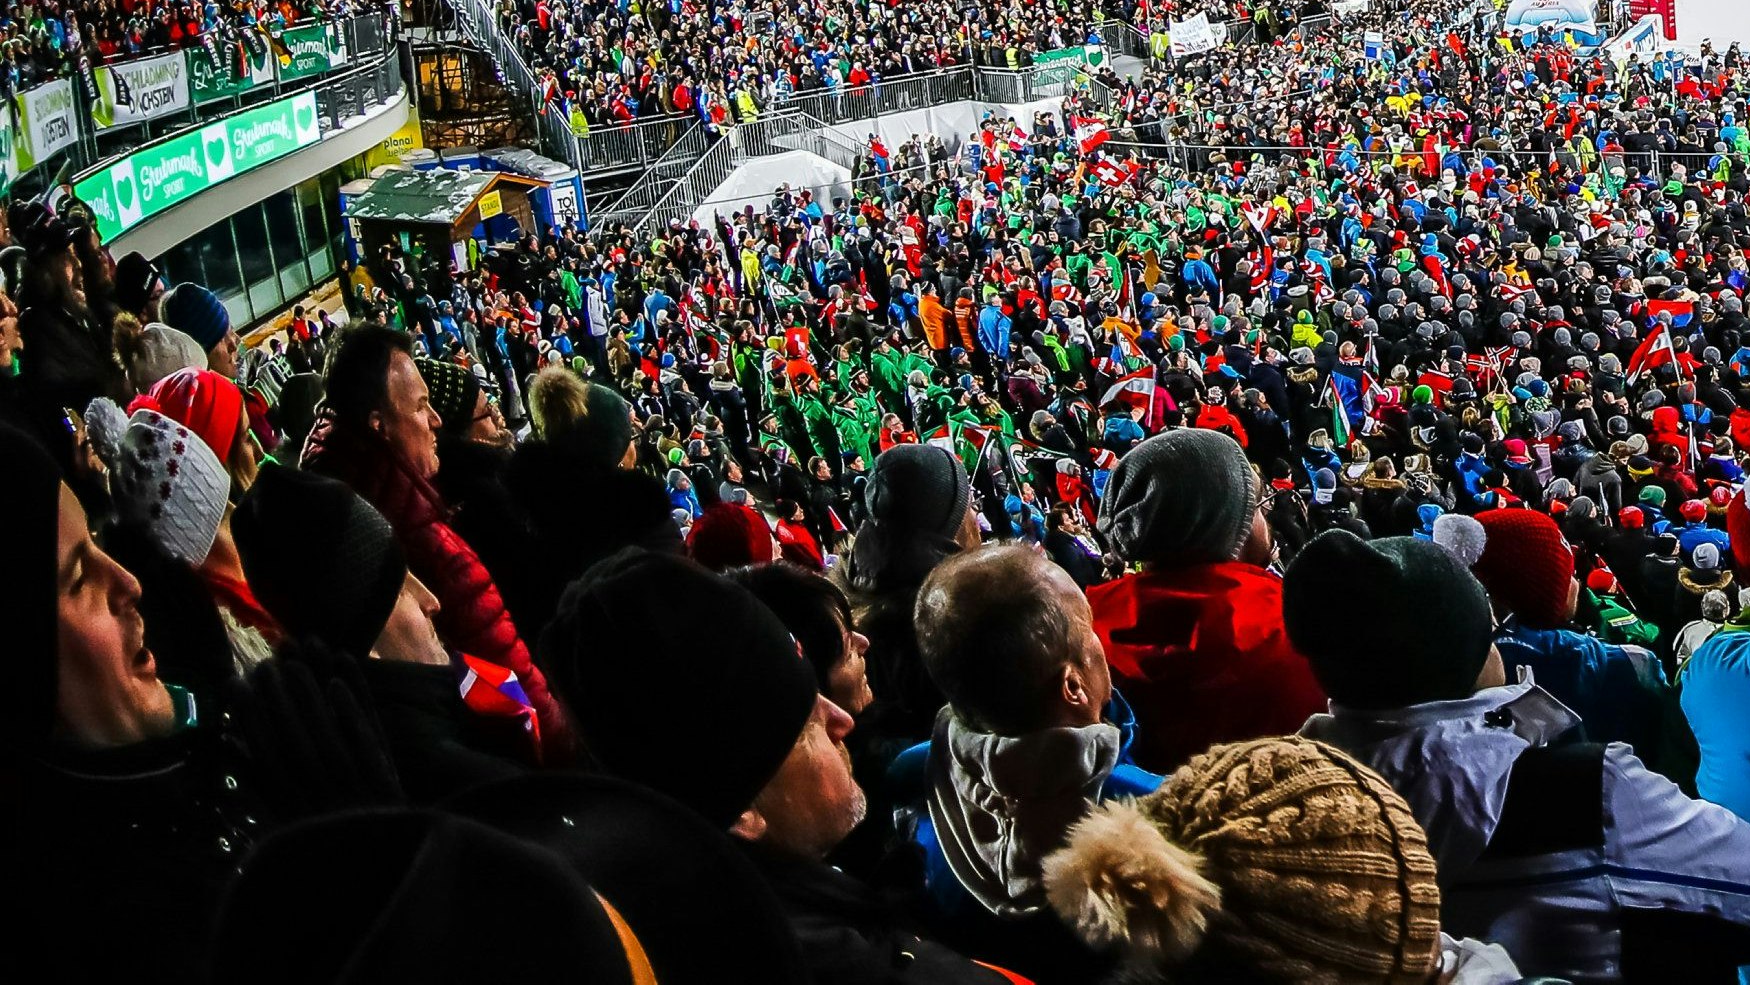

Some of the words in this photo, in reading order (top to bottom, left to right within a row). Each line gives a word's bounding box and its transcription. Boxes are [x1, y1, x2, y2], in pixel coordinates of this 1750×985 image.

[296, 58, 316, 70] SPORT
[124, 61, 179, 91] CHLADMING
[254, 141, 275, 157] SPORT
[383, 135, 413, 150] planai
[162, 180, 185, 199] SPORT
[558, 191, 575, 207] TOI
[559, 208, 576, 222] TOI
